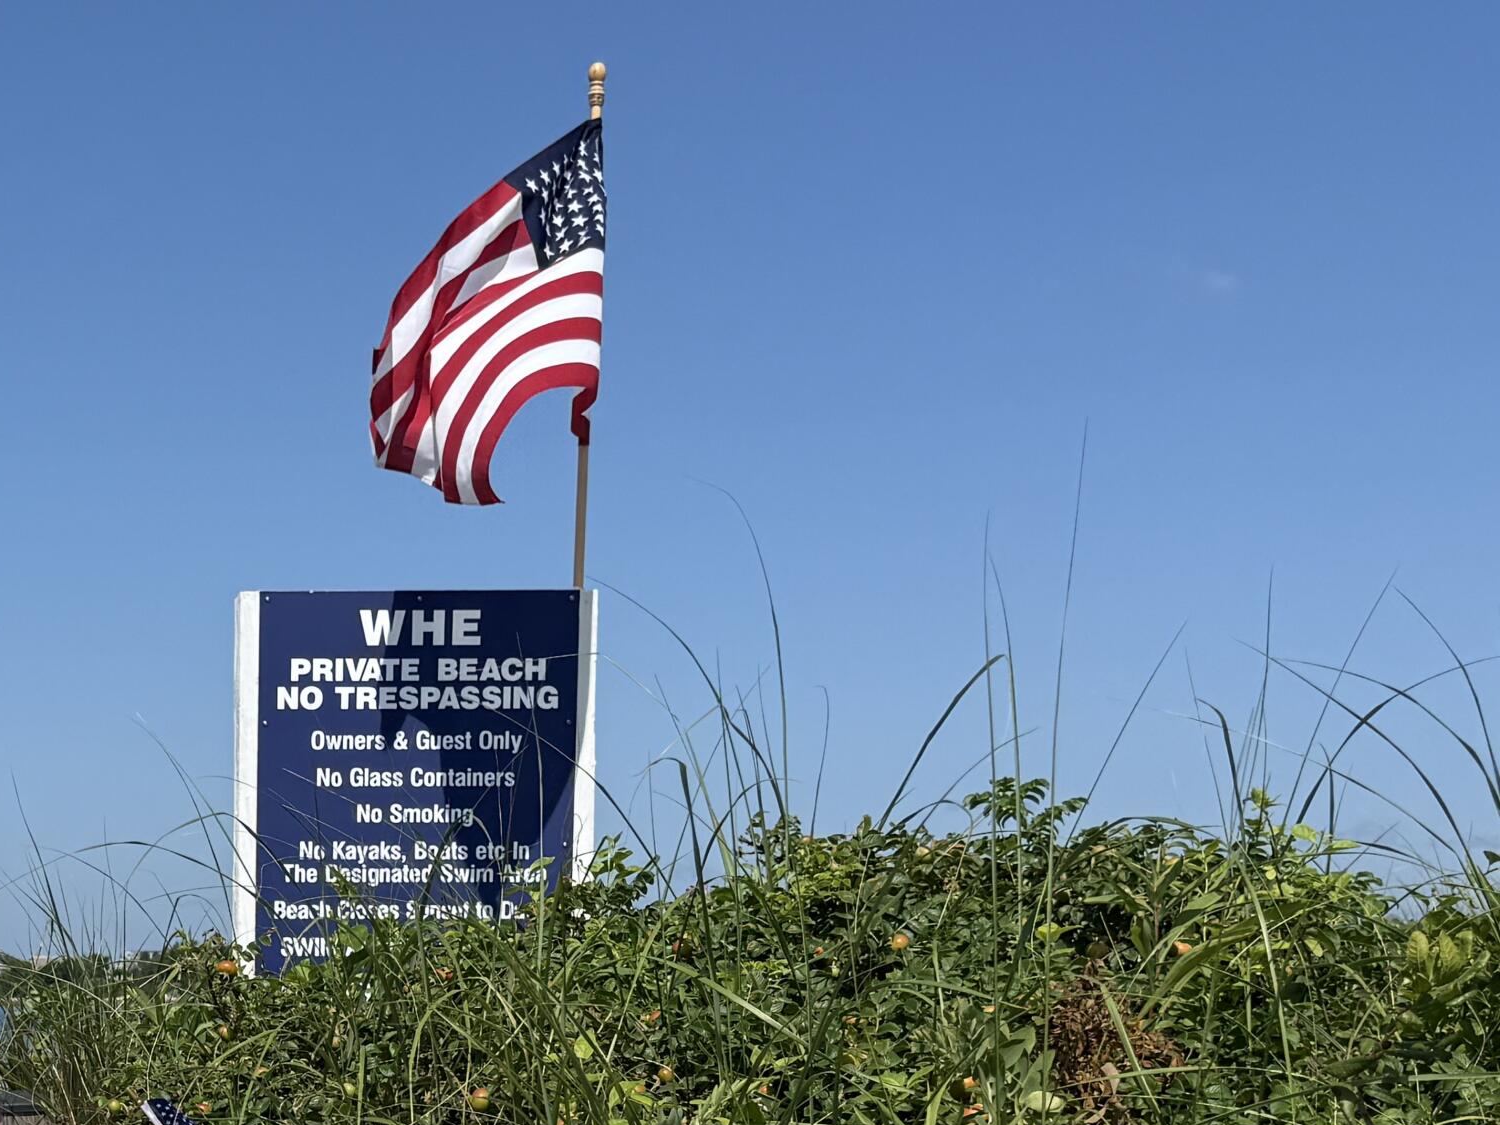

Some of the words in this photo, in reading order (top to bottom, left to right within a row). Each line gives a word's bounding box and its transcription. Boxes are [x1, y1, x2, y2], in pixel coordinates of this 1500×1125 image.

[359, 609, 482, 647] WHE
[290, 658, 420, 682] PRIVATE
[437, 657, 547, 682] BEACH
[276, 686, 324, 711] NO
[334, 686, 559, 711] TRESPASSING
[311, 731, 386, 751] Owners
[393, 731, 409, 751] &
[415, 731, 472, 751] Guest
[479, 730, 523, 754] Only
[316, 768, 343, 787] No
[349, 767, 404, 788] Glass
[410, 767, 515, 788] Containers
[356, 804, 382, 824] No
[389, 804, 474, 828] Smoking
[299, 841, 325, 860] No
[332, 841, 407, 864] Kayaks,
[414, 841, 469, 860] Boats
[476, 842, 505, 860] etc
[512, 841, 530, 860] In
[284, 863, 318, 883] The
[325, 863, 433, 887] Designated
[439, 863, 494, 883] Swim
[503, 863, 548, 883] Area
[273, 900, 334, 920] Beach
[475, 901, 494, 919] to
